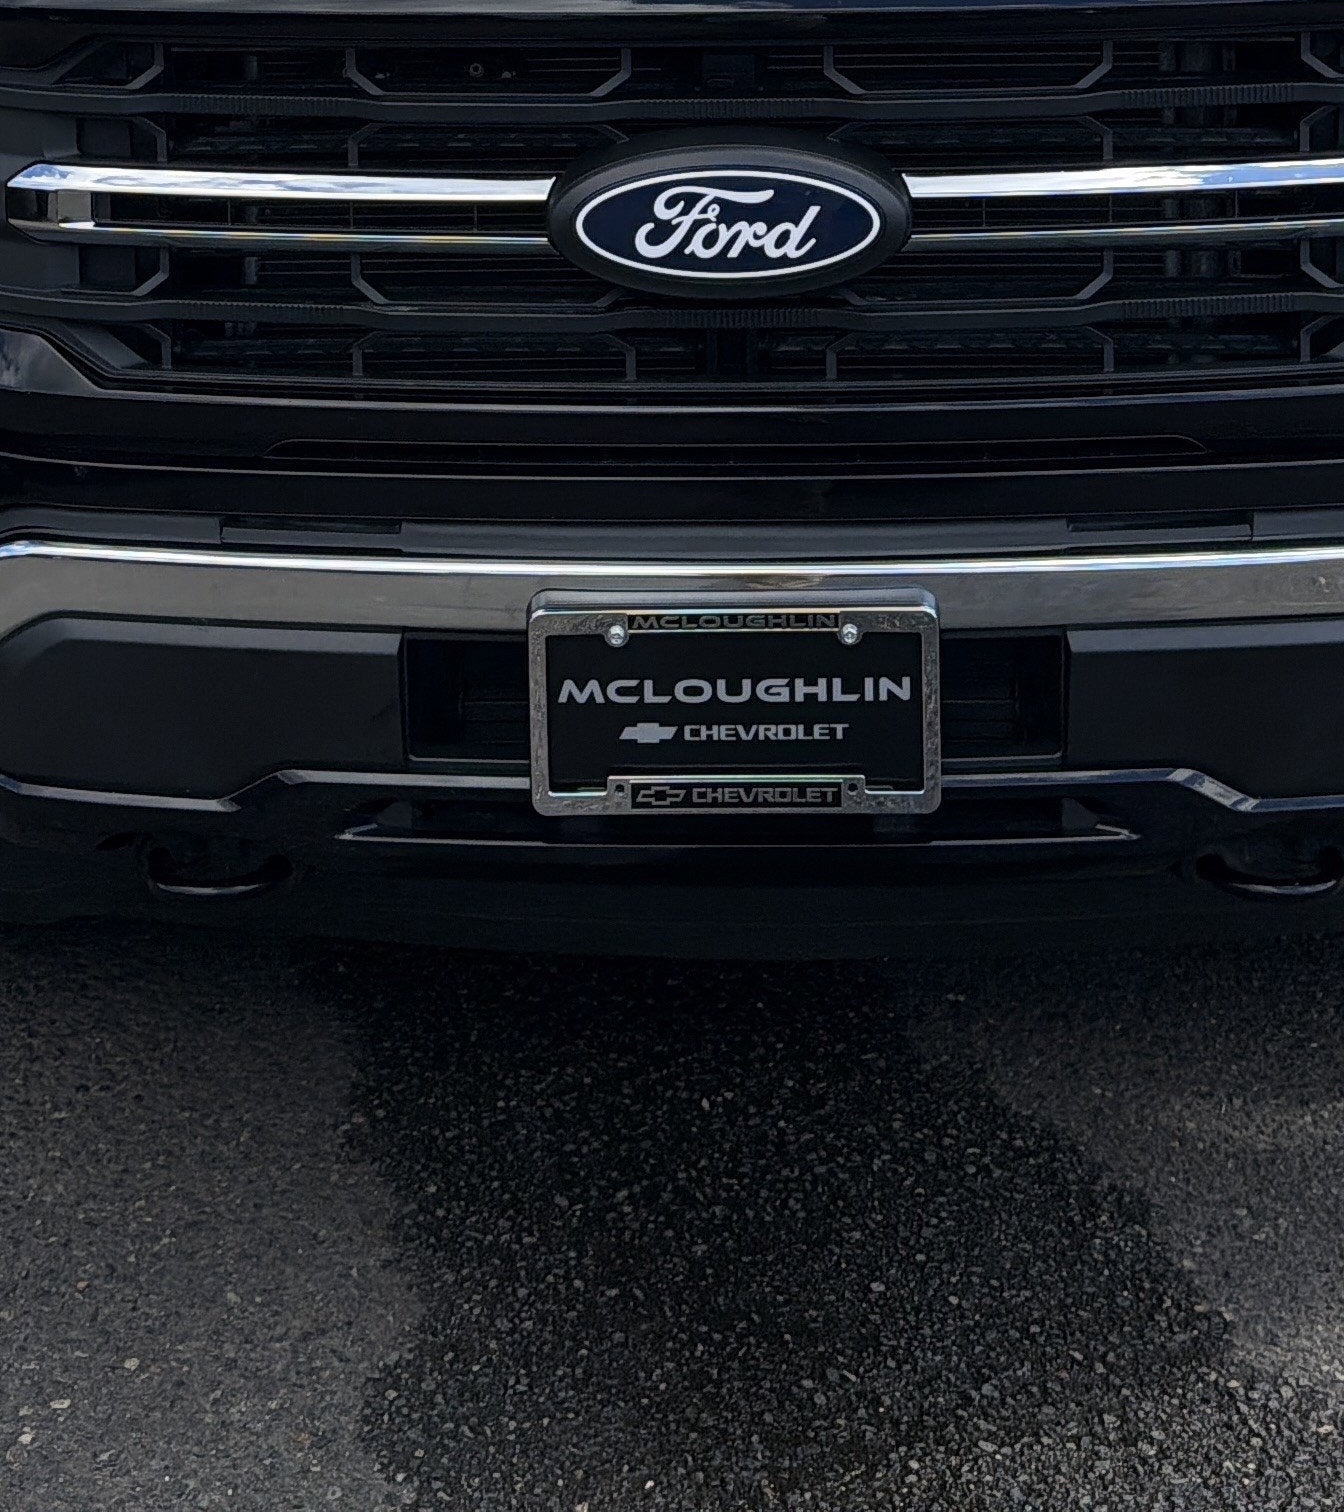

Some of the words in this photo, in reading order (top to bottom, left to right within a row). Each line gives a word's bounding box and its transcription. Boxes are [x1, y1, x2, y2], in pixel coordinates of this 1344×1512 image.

[635, 186, 821, 258] Ford
[631, 614, 838, 630] MCLOUGHLIN
[557, 676, 911, 704] MCLOUGHLIN
[683, 723, 850, 741] CHEVROLET
[691, 788, 838, 804] CHEVROLET
